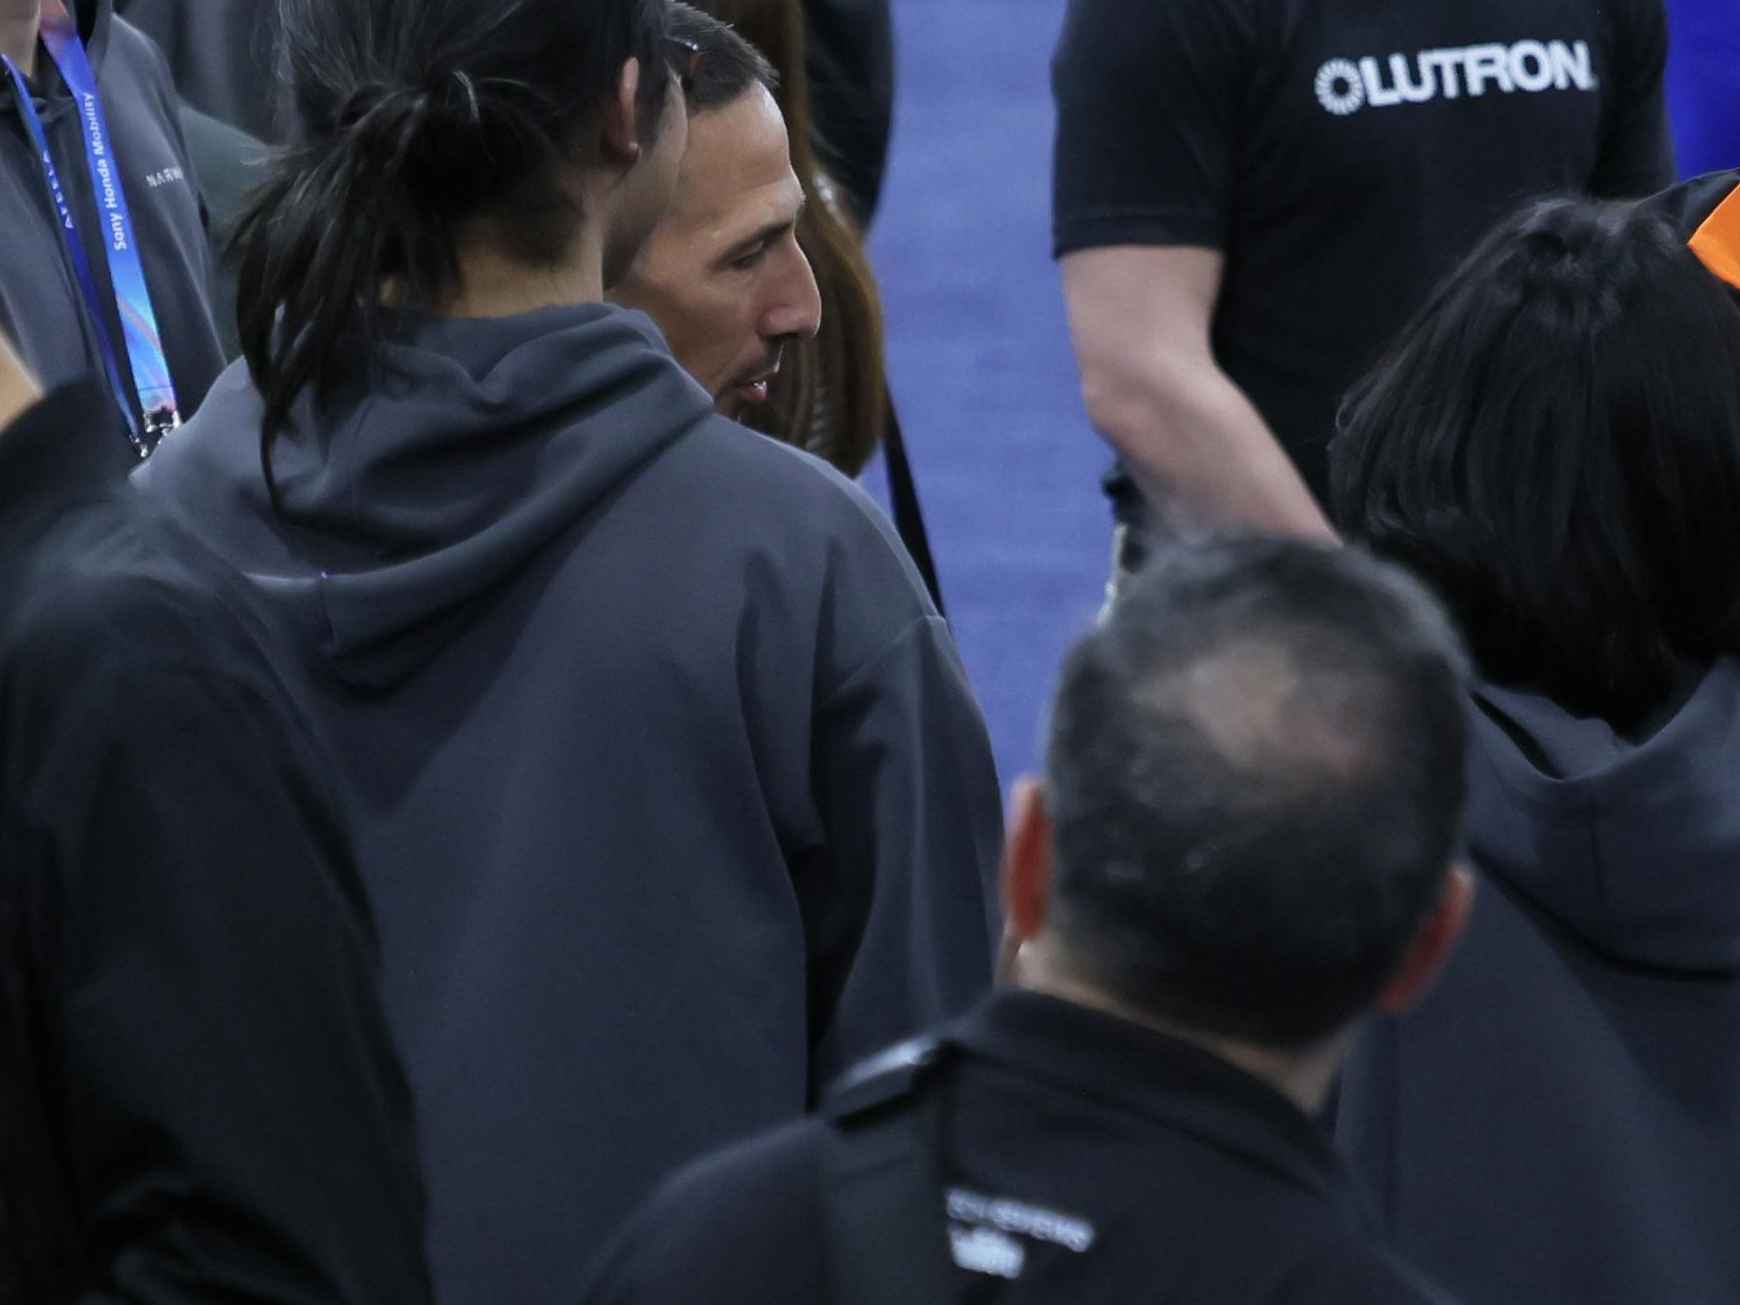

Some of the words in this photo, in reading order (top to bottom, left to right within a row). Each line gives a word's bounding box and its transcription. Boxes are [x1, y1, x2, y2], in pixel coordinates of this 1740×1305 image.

[83, 92, 104, 155] Mobility
[98, 159, 118, 208] Honda
[110, 213, 127, 250] Sony
